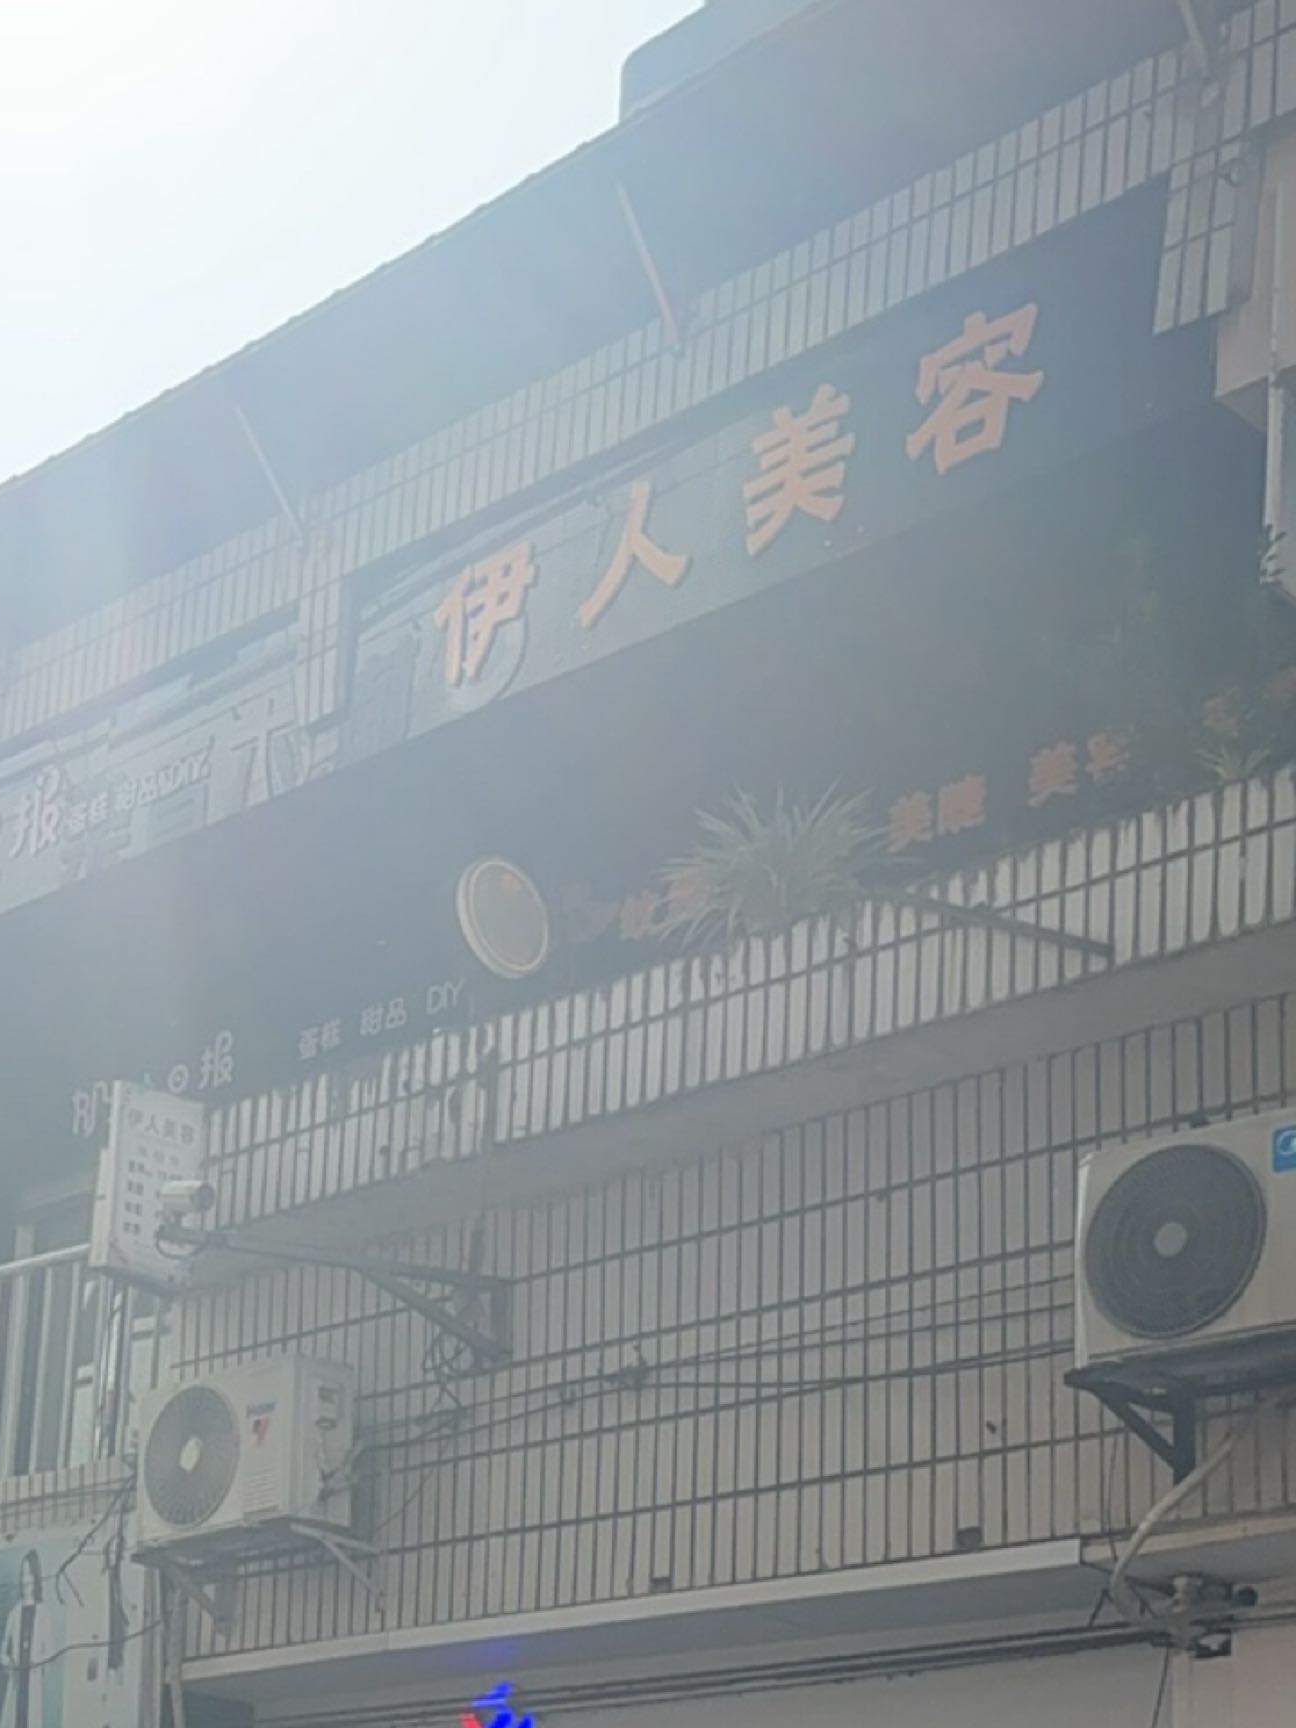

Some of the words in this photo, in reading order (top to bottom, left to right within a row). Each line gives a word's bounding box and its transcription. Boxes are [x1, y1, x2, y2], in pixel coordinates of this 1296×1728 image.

[432, 303, 1045, 688] 伊人美容
[426, 977, 466, 1015] DIY
